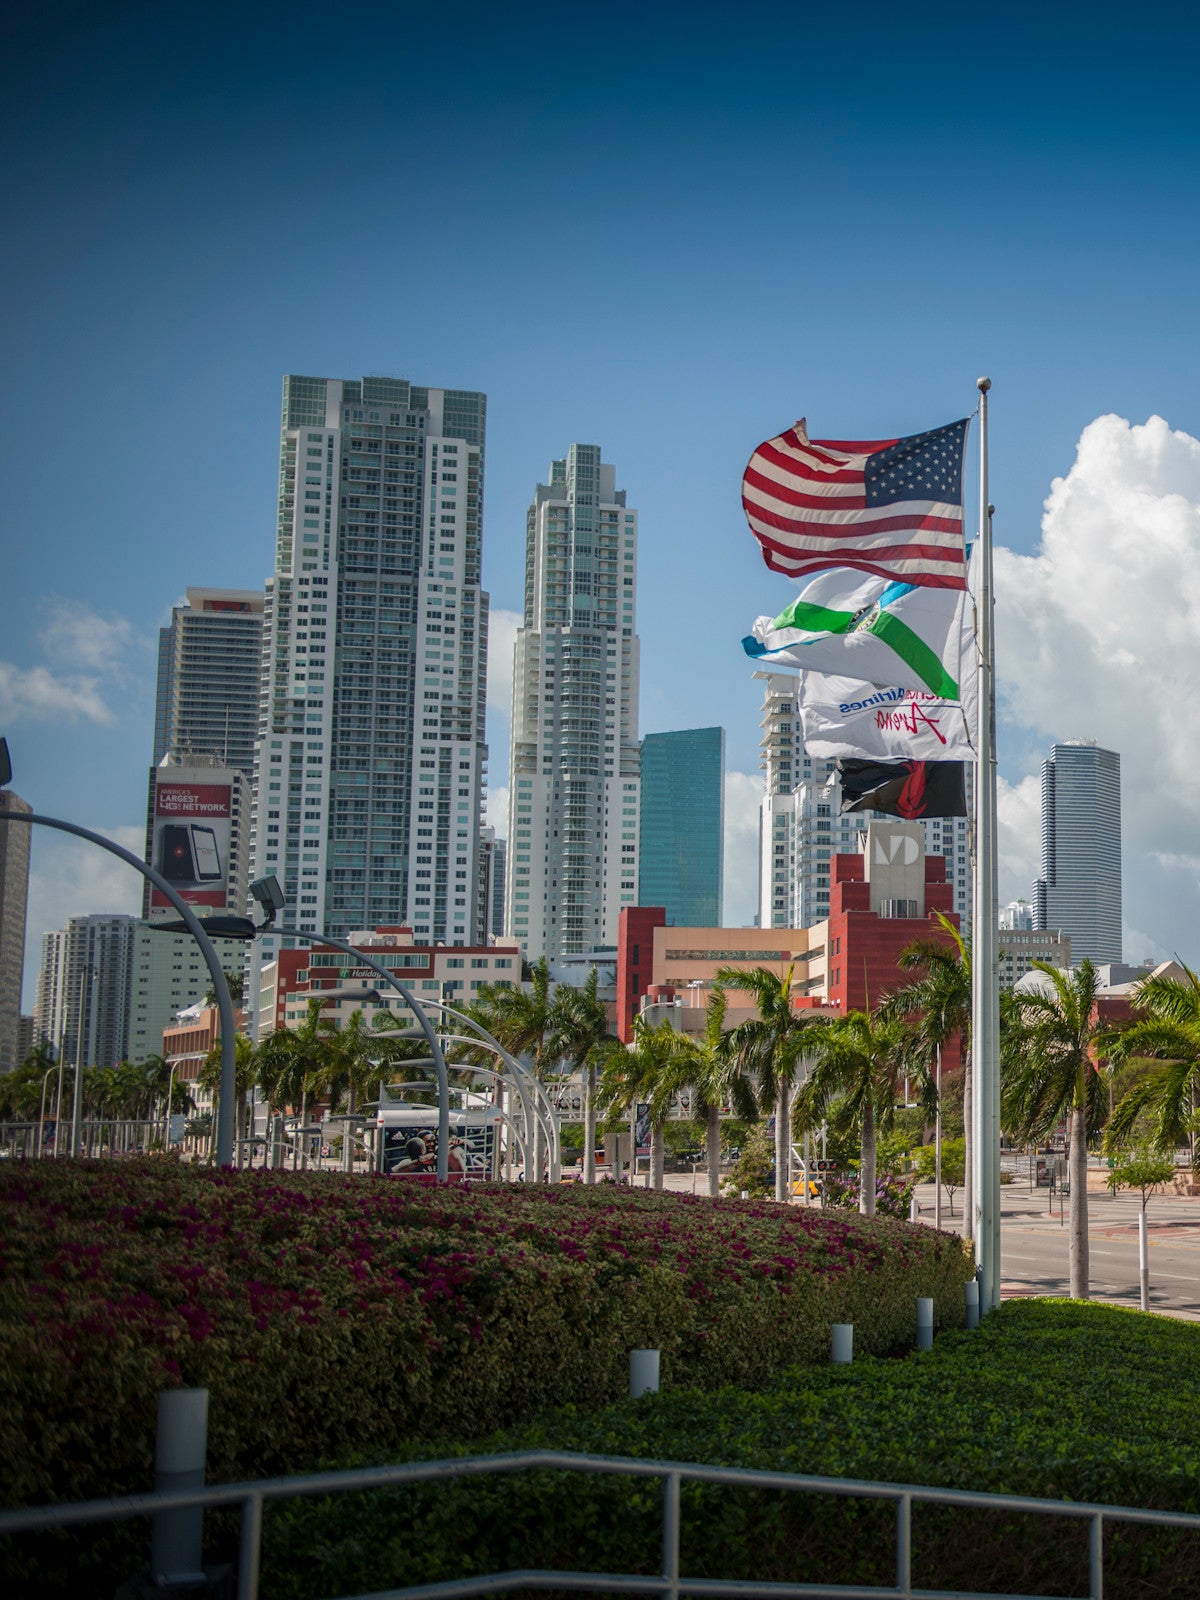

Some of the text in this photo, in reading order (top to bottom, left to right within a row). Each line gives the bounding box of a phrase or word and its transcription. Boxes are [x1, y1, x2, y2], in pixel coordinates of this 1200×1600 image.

[160, 795, 200, 803] LARGEST
[183, 803, 228, 812] NETWORK.
[352, 969, 382, 979] Holiday
